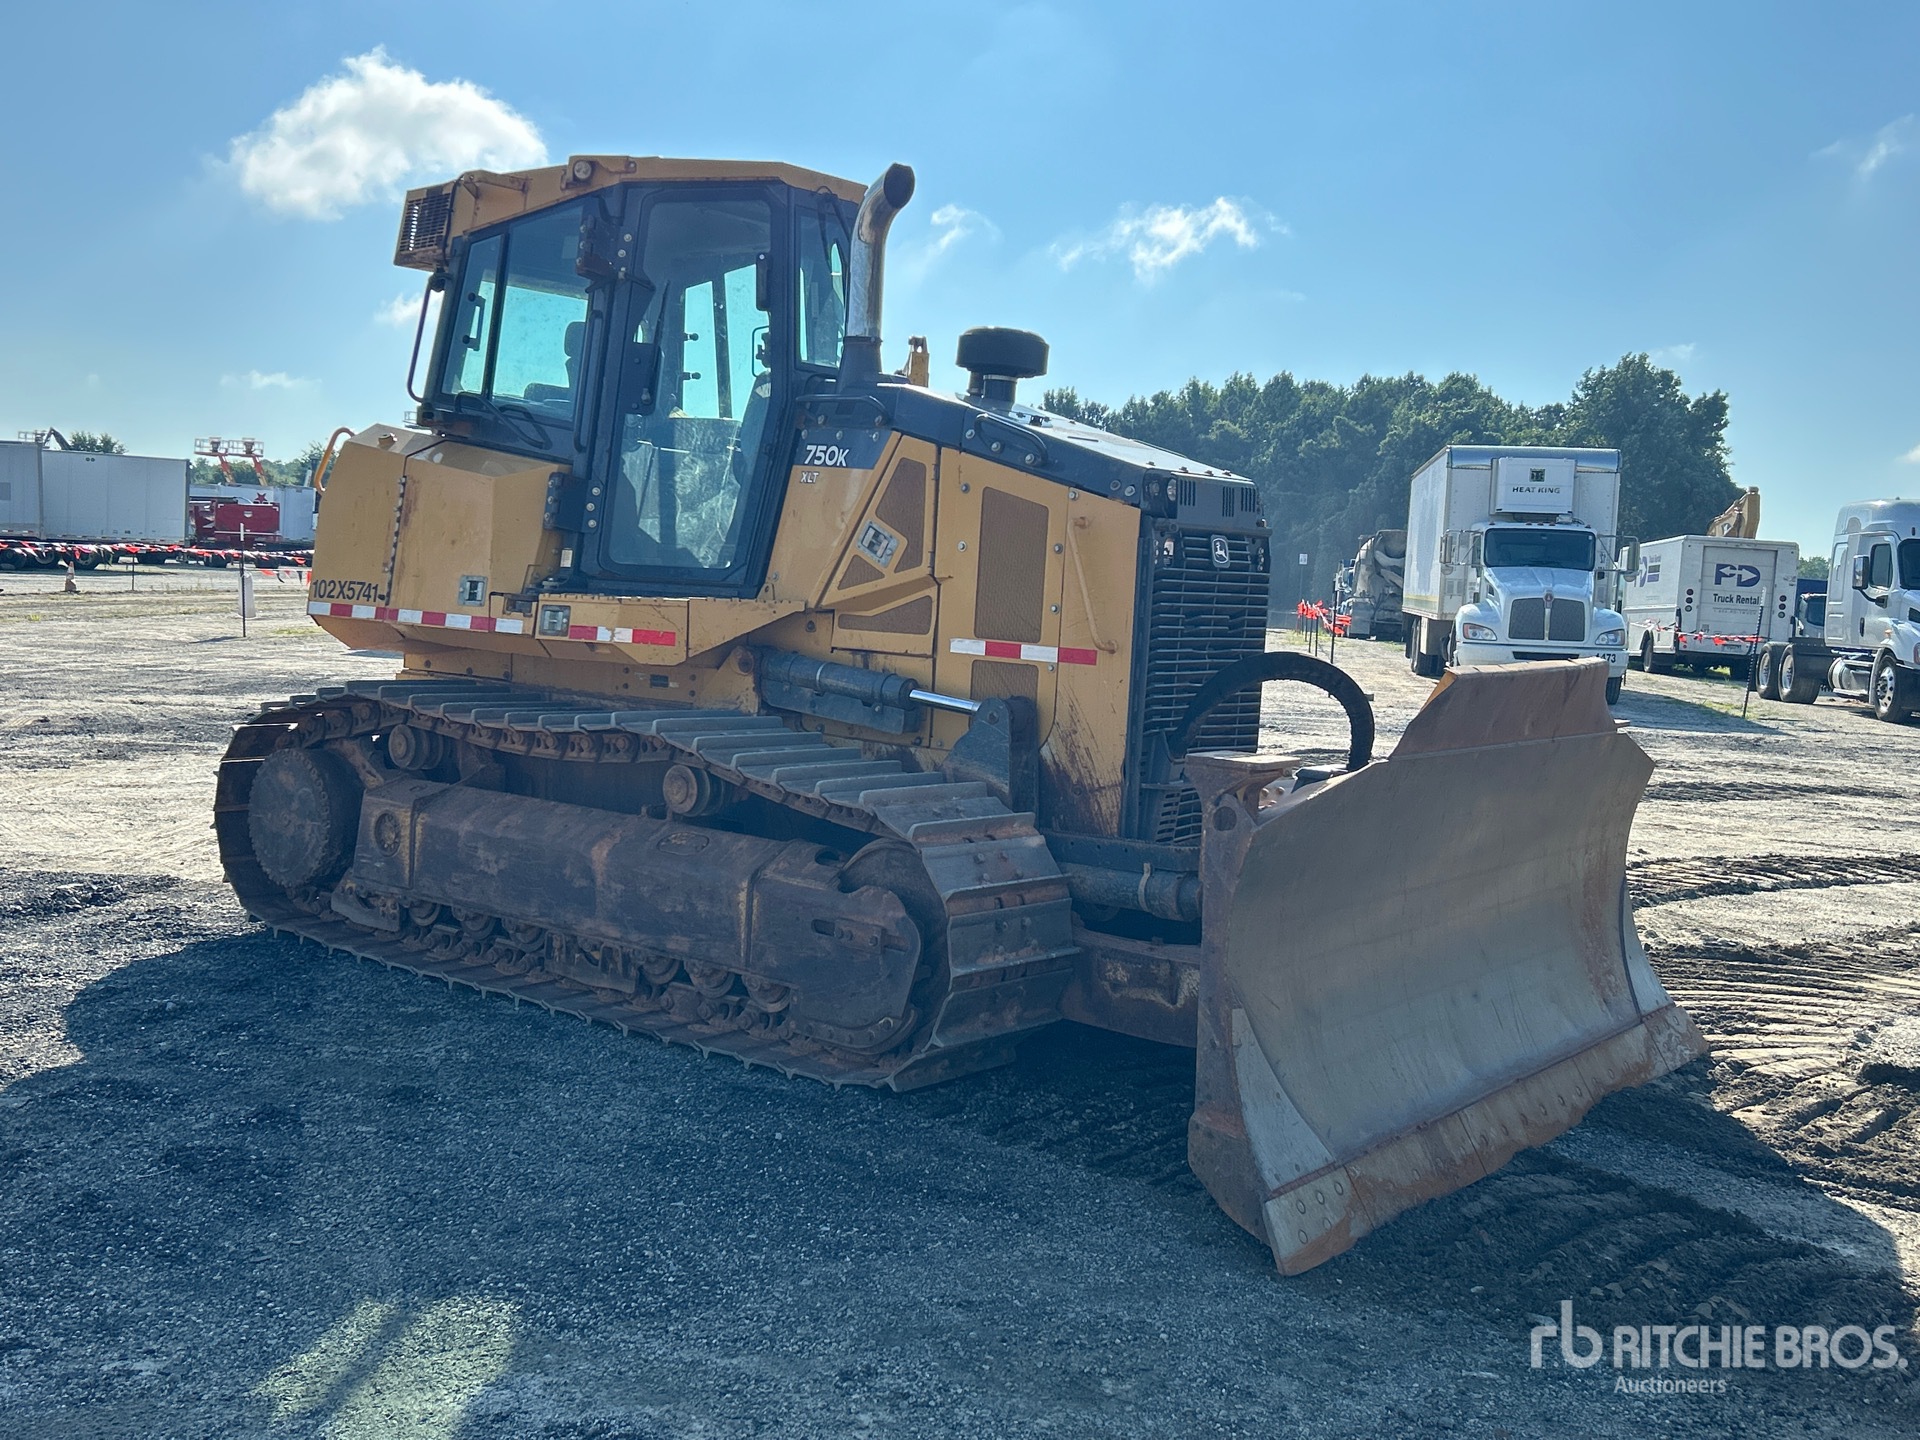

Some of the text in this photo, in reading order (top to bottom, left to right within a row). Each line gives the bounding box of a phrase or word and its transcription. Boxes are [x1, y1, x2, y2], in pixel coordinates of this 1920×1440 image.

[804, 444, 850, 467] 750K
[800, 471, 820, 484] XLT
[312, 579, 379, 602] 102X5741
[1713, 593, 1760, 605] Truck Rental
